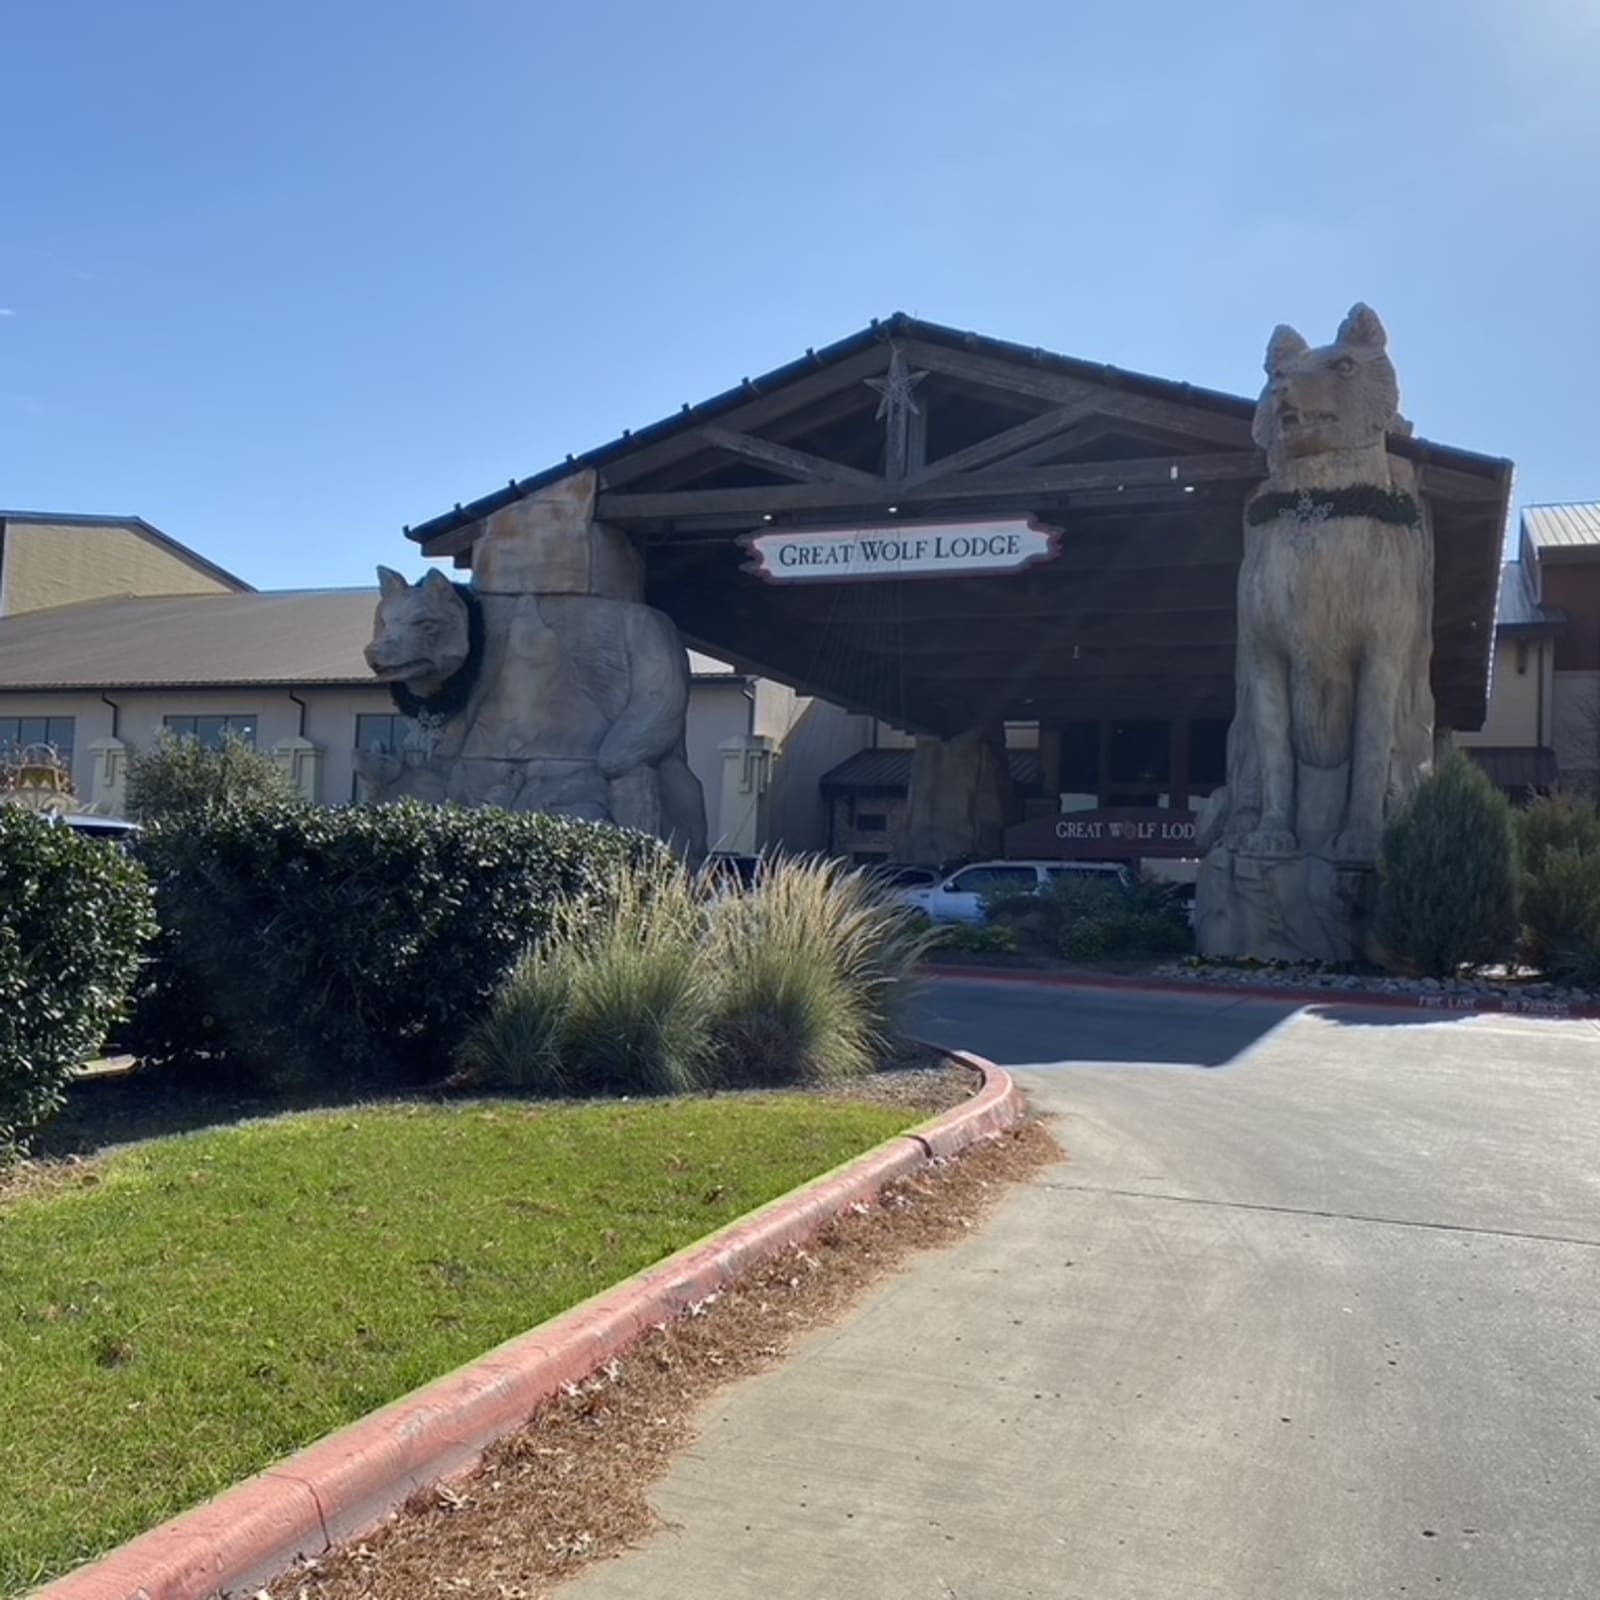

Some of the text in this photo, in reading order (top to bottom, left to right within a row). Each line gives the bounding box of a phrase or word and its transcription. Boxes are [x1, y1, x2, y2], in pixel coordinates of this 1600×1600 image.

[779, 535, 1020, 567] GREAT WOLF LODGE
[1056, 821, 1103, 838] GREAT
[1162, 822, 1196, 840] LOD
